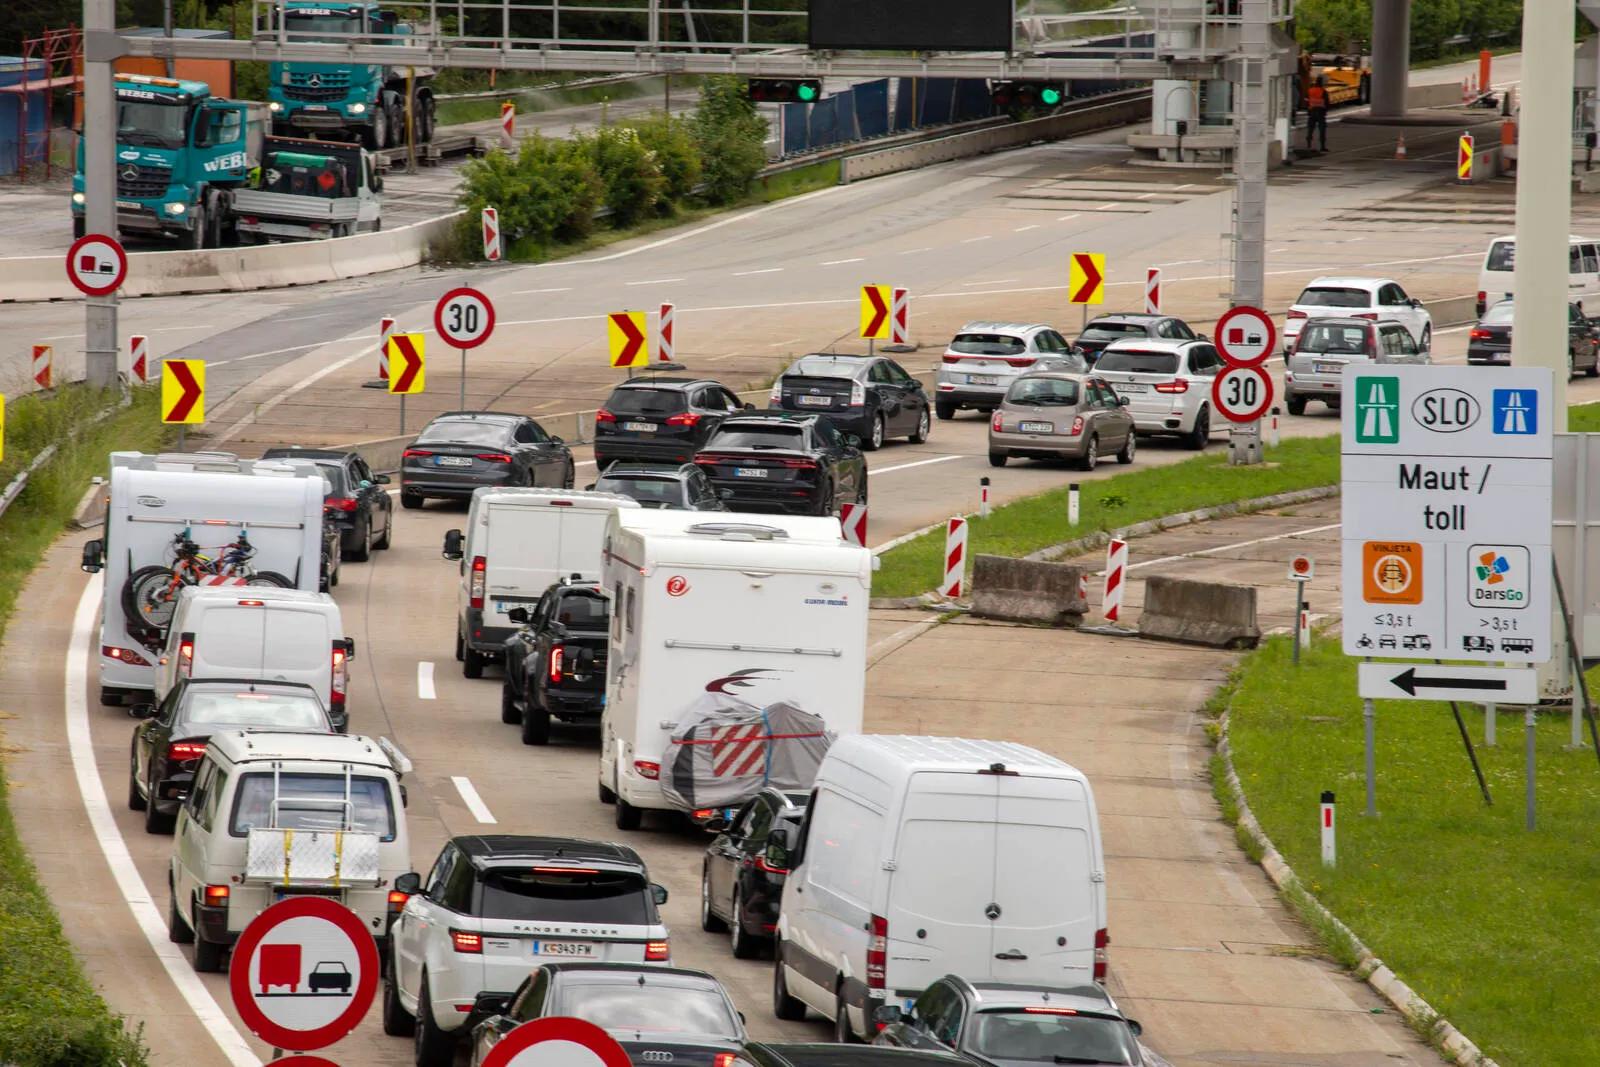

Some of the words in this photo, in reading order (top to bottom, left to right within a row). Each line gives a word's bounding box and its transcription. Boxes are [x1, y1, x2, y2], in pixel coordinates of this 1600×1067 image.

[203, 151, 248, 172] WEB
[449, 303, 478, 333] 30
[1227, 376, 1257, 406] 30
[1423, 397, 1470, 425] SLO
[1399, 463, 1470, 490] Maut
[1477, 463, 1492, 494] /
[1423, 504, 1466, 531] toll
[1372, 544, 1413, 553] VINJETA
[1475, 588, 1524, 601] DarsGo
[513, 925, 560, 933] RANGE
